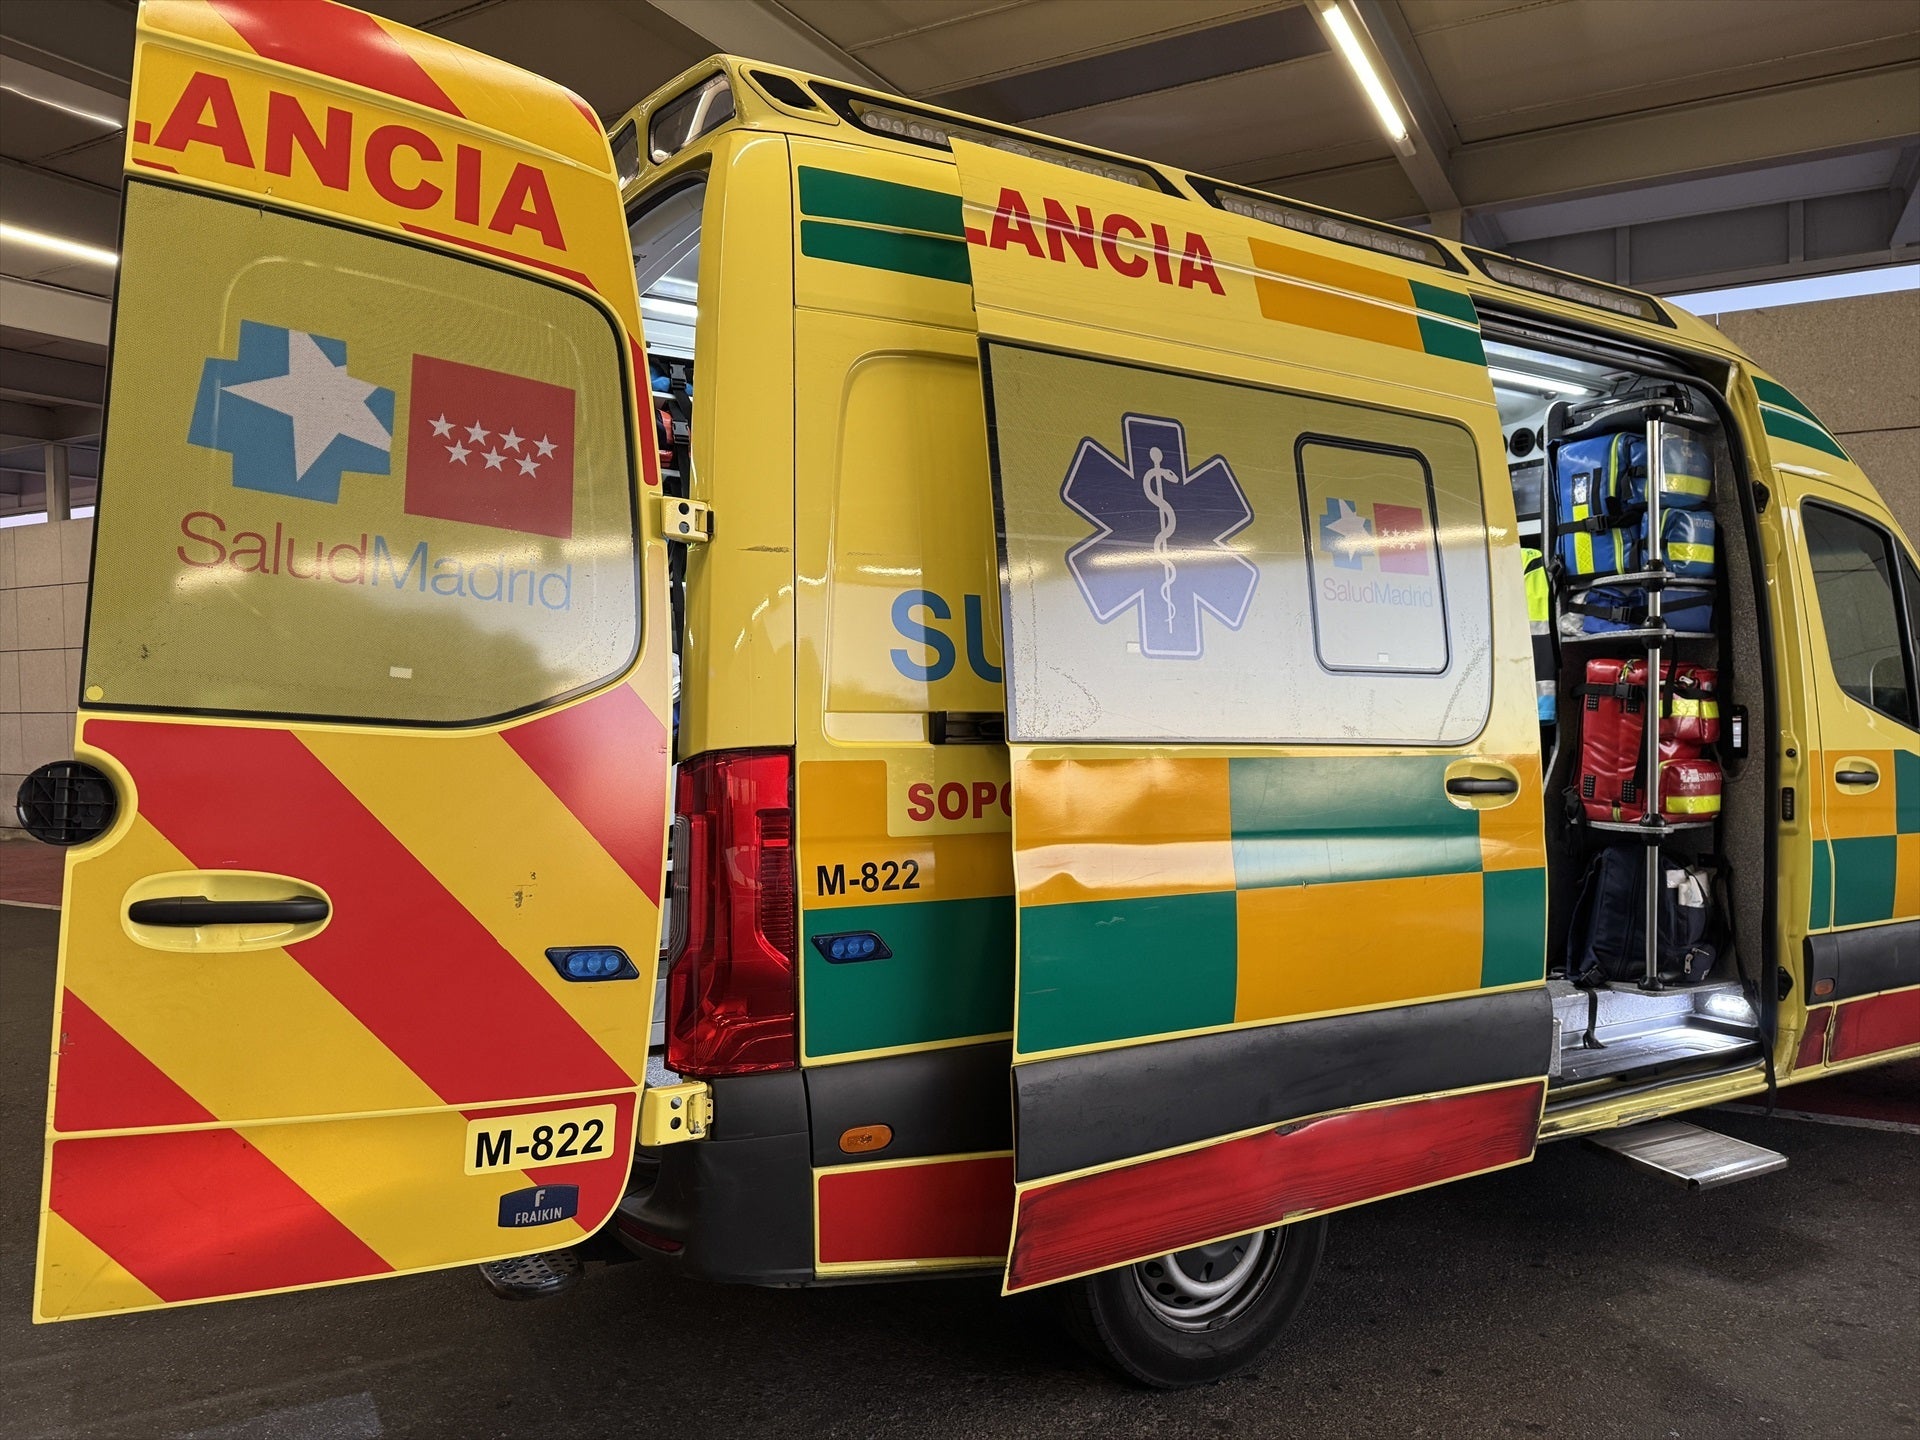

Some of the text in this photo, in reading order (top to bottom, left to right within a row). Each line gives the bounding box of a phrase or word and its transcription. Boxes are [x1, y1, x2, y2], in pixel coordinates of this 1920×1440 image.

[133, 71, 567, 252] ANCIA
[176, 511, 572, 612] SaludMadrid
[1323, 577, 1434, 608] SaludMadrid
[816, 859, 921, 896] M-822
[475, 1119, 604, 1168] M-822
[515, 1207, 562, 1225] FRAIKIN
